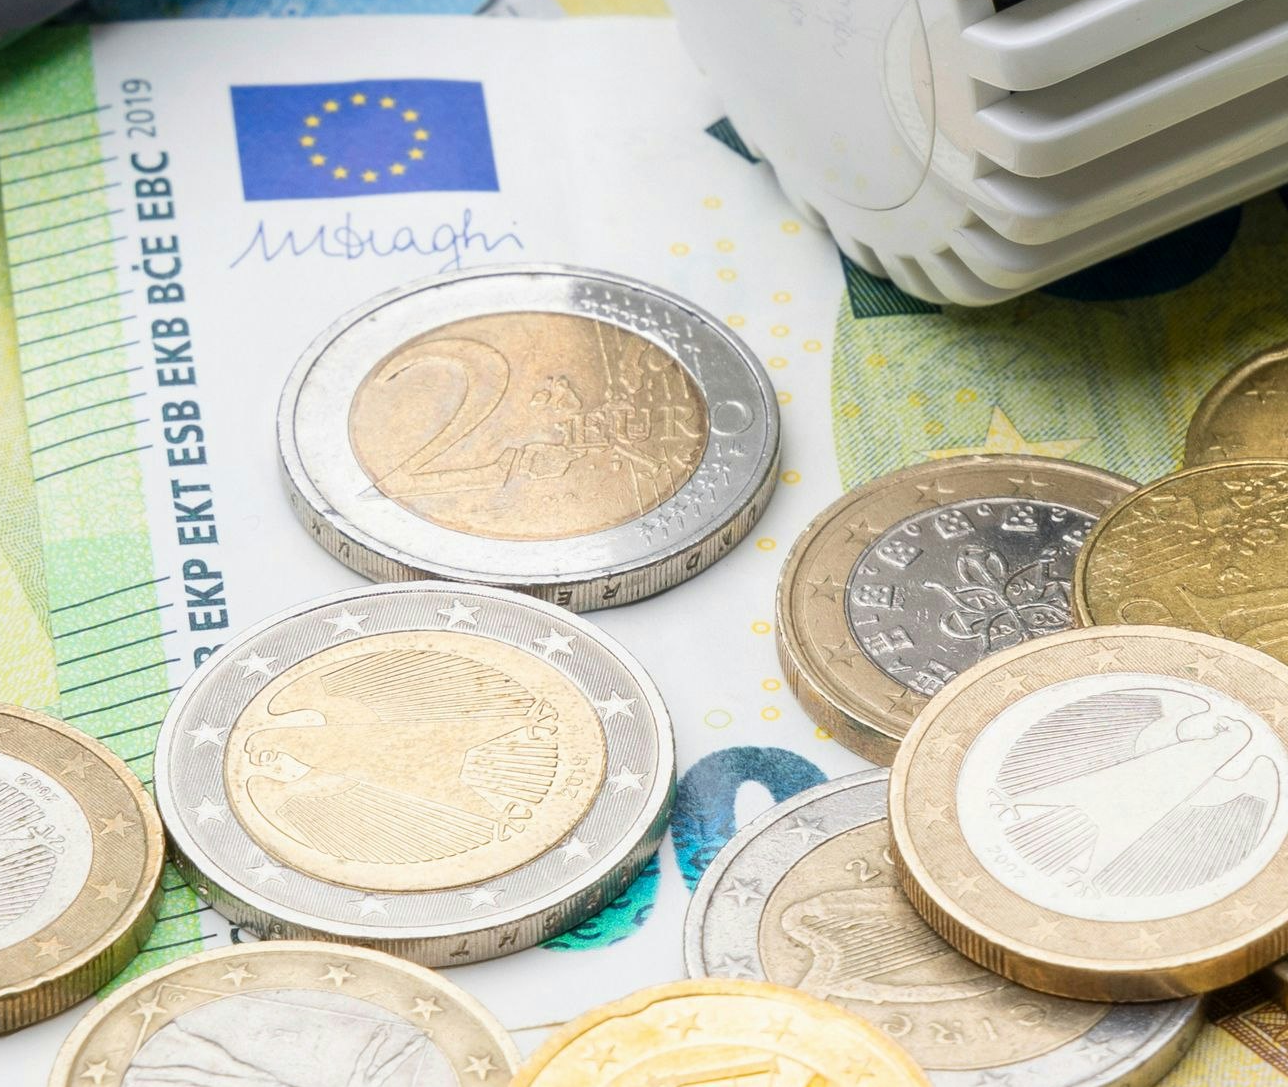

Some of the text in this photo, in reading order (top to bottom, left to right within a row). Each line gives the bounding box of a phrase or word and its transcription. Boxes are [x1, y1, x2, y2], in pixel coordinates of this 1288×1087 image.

[121, 77, 157, 139] 2019
[130, 150, 176, 222] EBC
[151, 317, 197, 387] EKB
[162, 399, 208, 467] ESB
[170, 479, 219, 546] EKT
[182, 558, 229, 632] EKP
